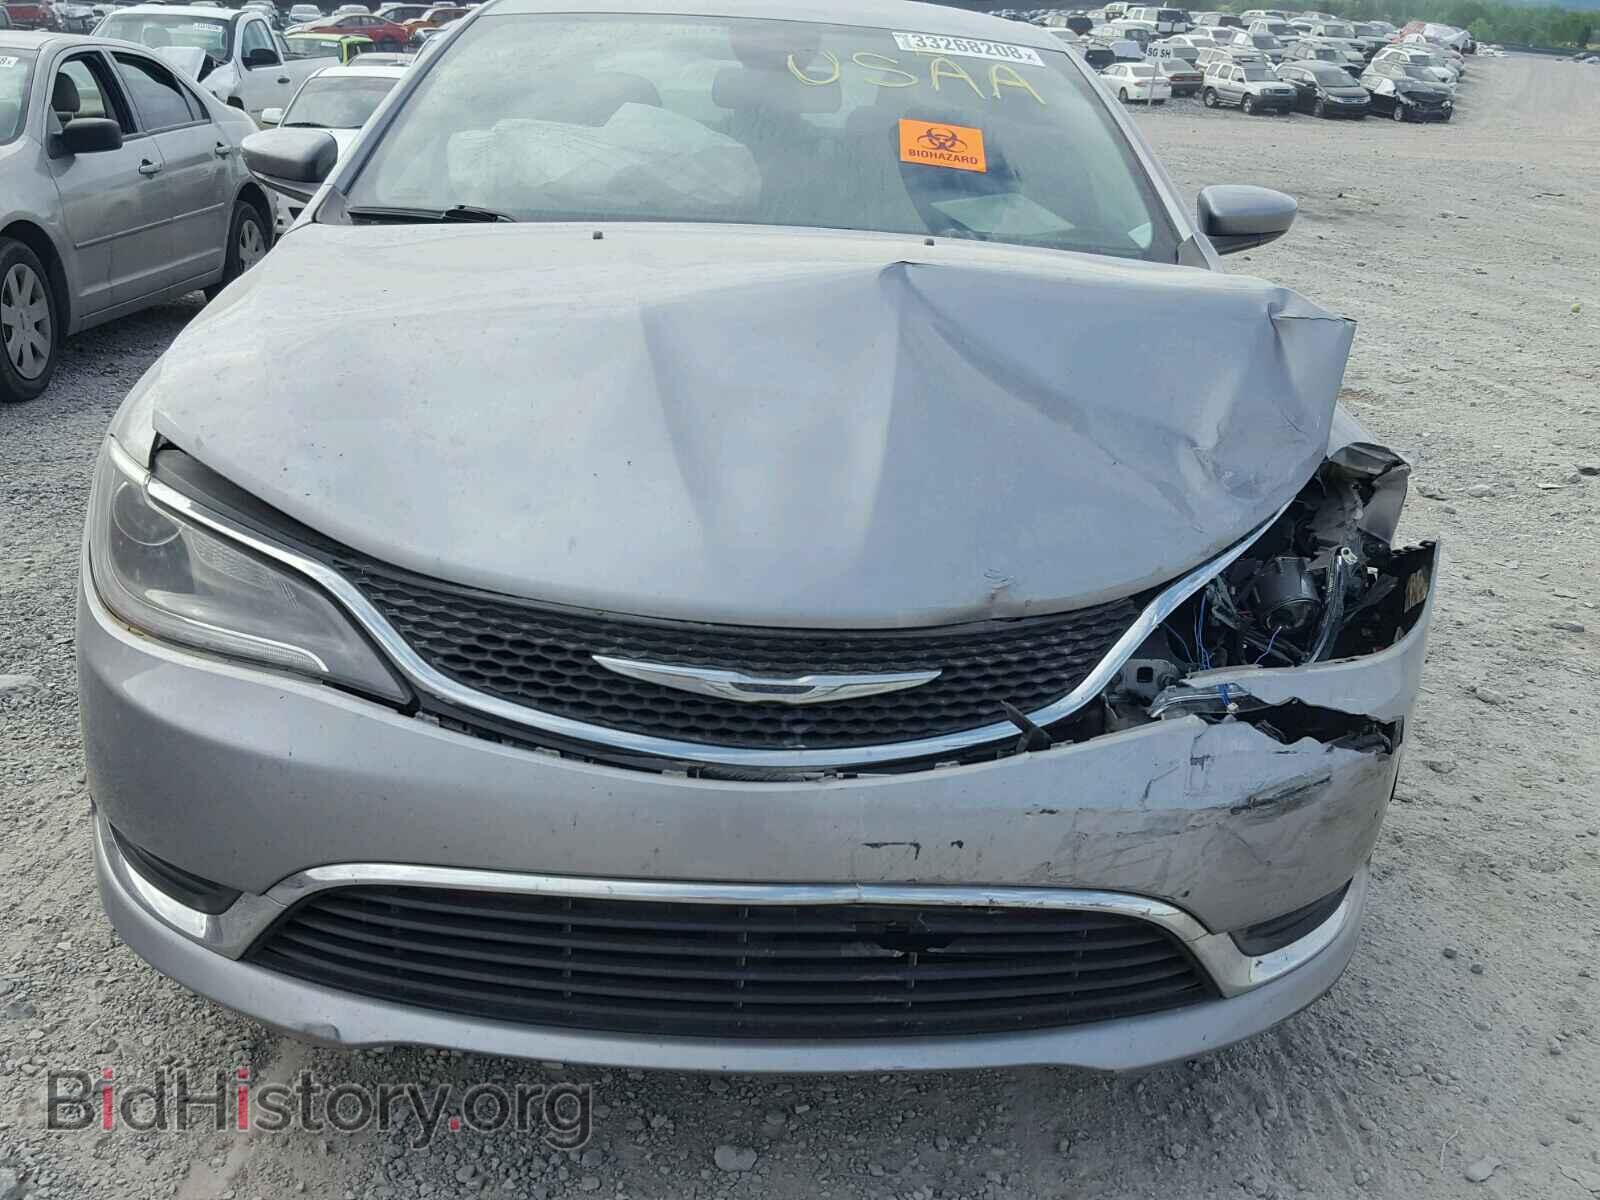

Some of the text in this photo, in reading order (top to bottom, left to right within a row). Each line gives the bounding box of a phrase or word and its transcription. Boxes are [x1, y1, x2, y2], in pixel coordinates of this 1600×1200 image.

[912, 34, 1022, 60] 33268208
[787, 50, 1047, 104] USAA
[908, 149, 978, 165] BIOHAZARD
